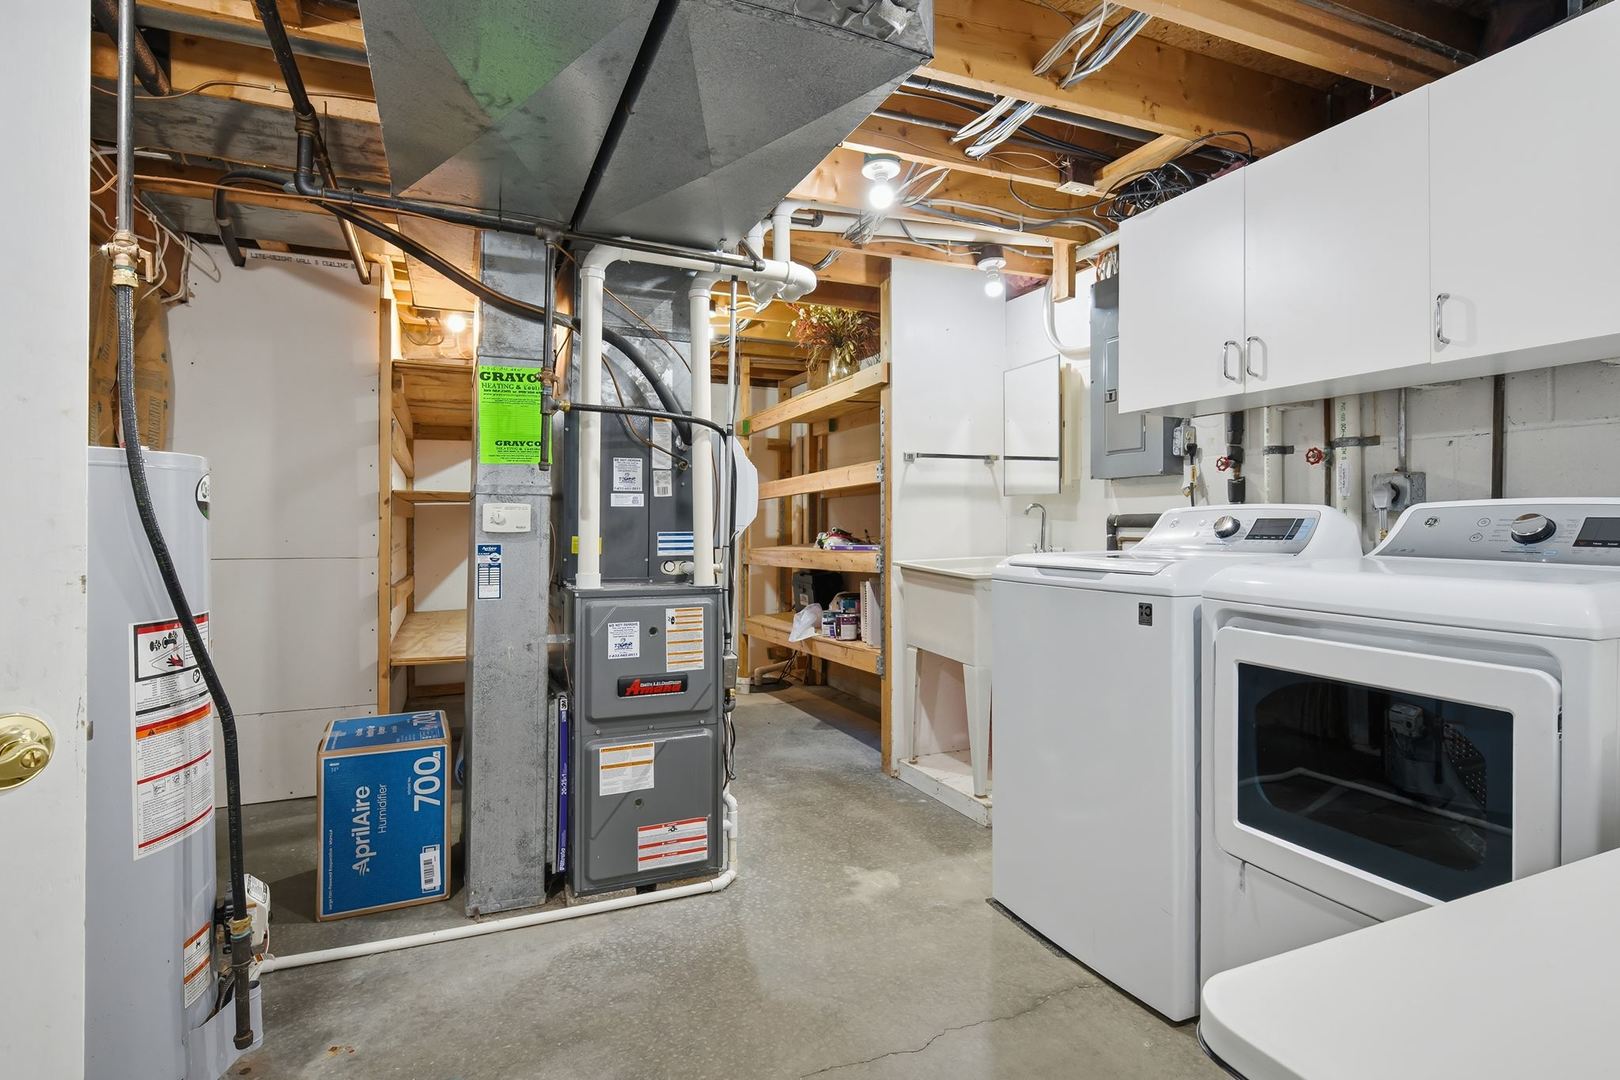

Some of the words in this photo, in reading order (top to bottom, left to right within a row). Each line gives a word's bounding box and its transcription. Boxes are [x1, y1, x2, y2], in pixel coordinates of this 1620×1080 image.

[625, 678, 682, 696] Amana
[378, 783, 388, 834] Humidifier
[413, 756, 441, 812] 700
[352, 785, 377, 877] AprilAire
